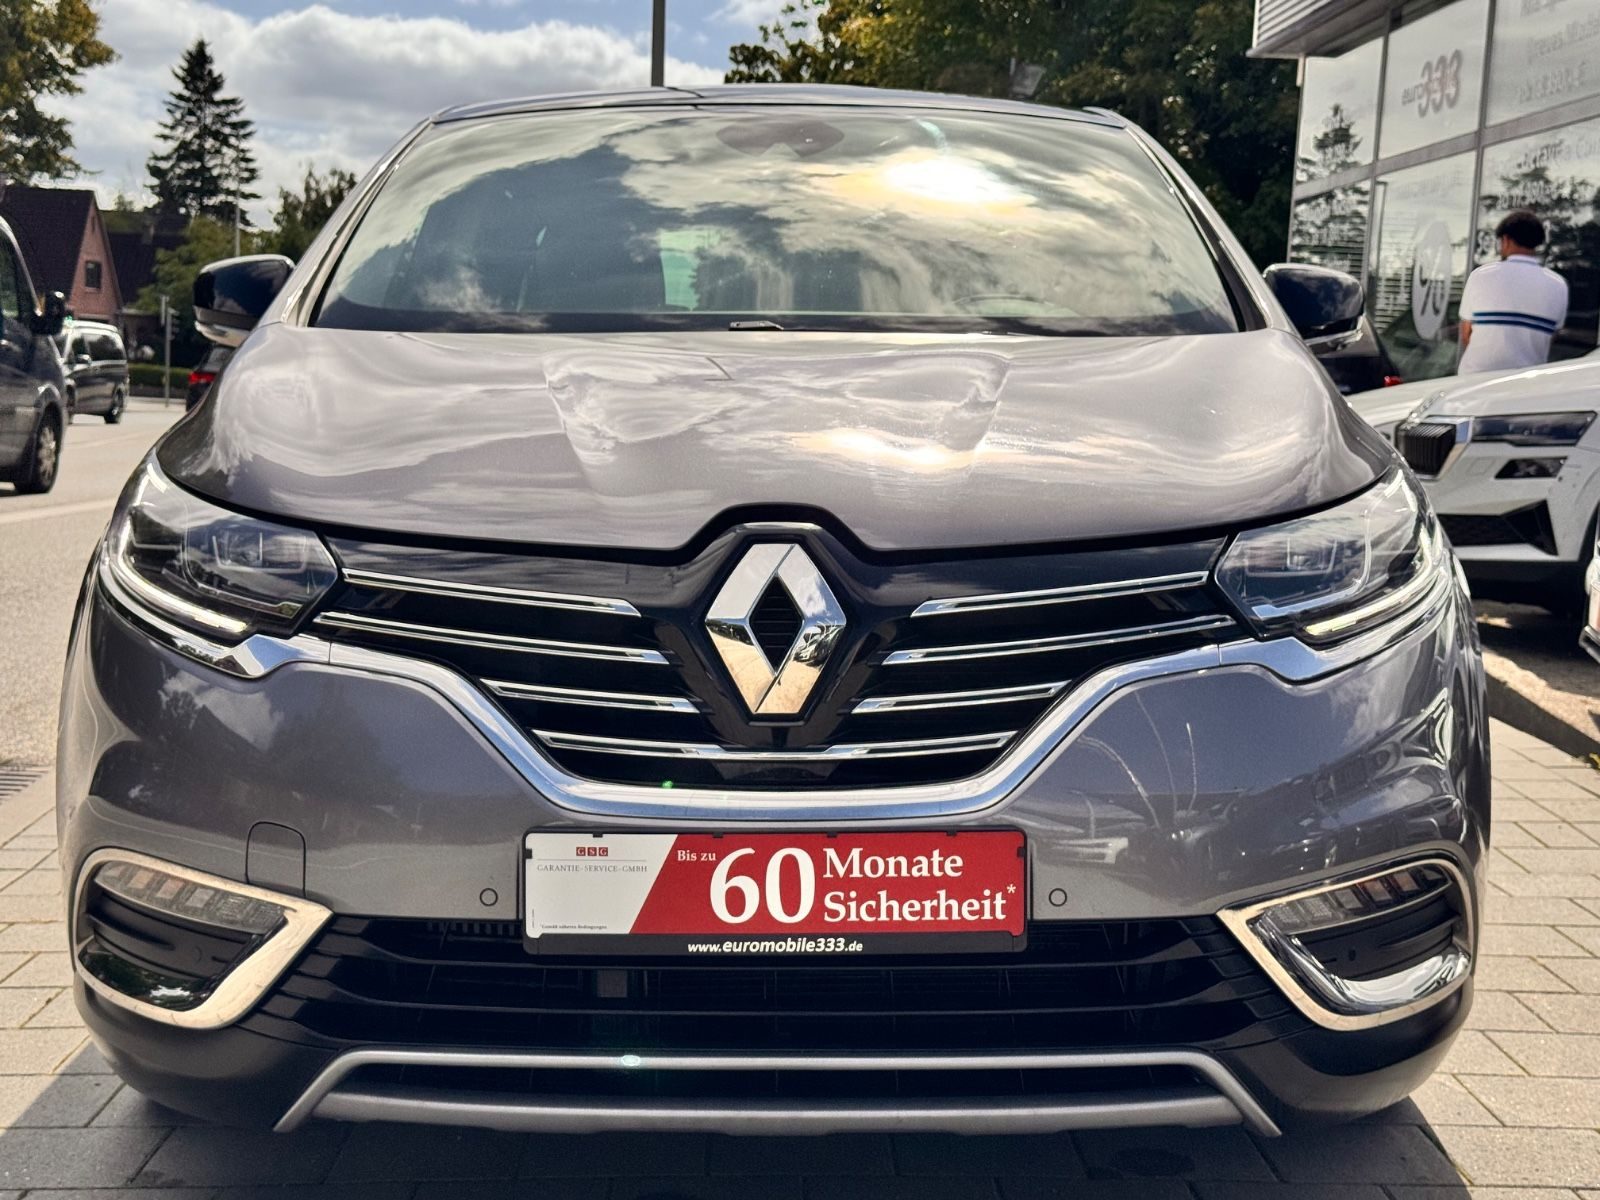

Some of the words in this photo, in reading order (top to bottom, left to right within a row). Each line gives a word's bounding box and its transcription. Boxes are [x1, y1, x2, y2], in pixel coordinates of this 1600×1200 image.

[576, 847, 608, 857] GSG
[677, 849, 698, 862] Bis
[700, 852, 717, 862] zu
[823, 847, 963, 878] Monate
[710, 847, 816, 924] 60
[687, 937, 864, 953] www.euromobile333.de
